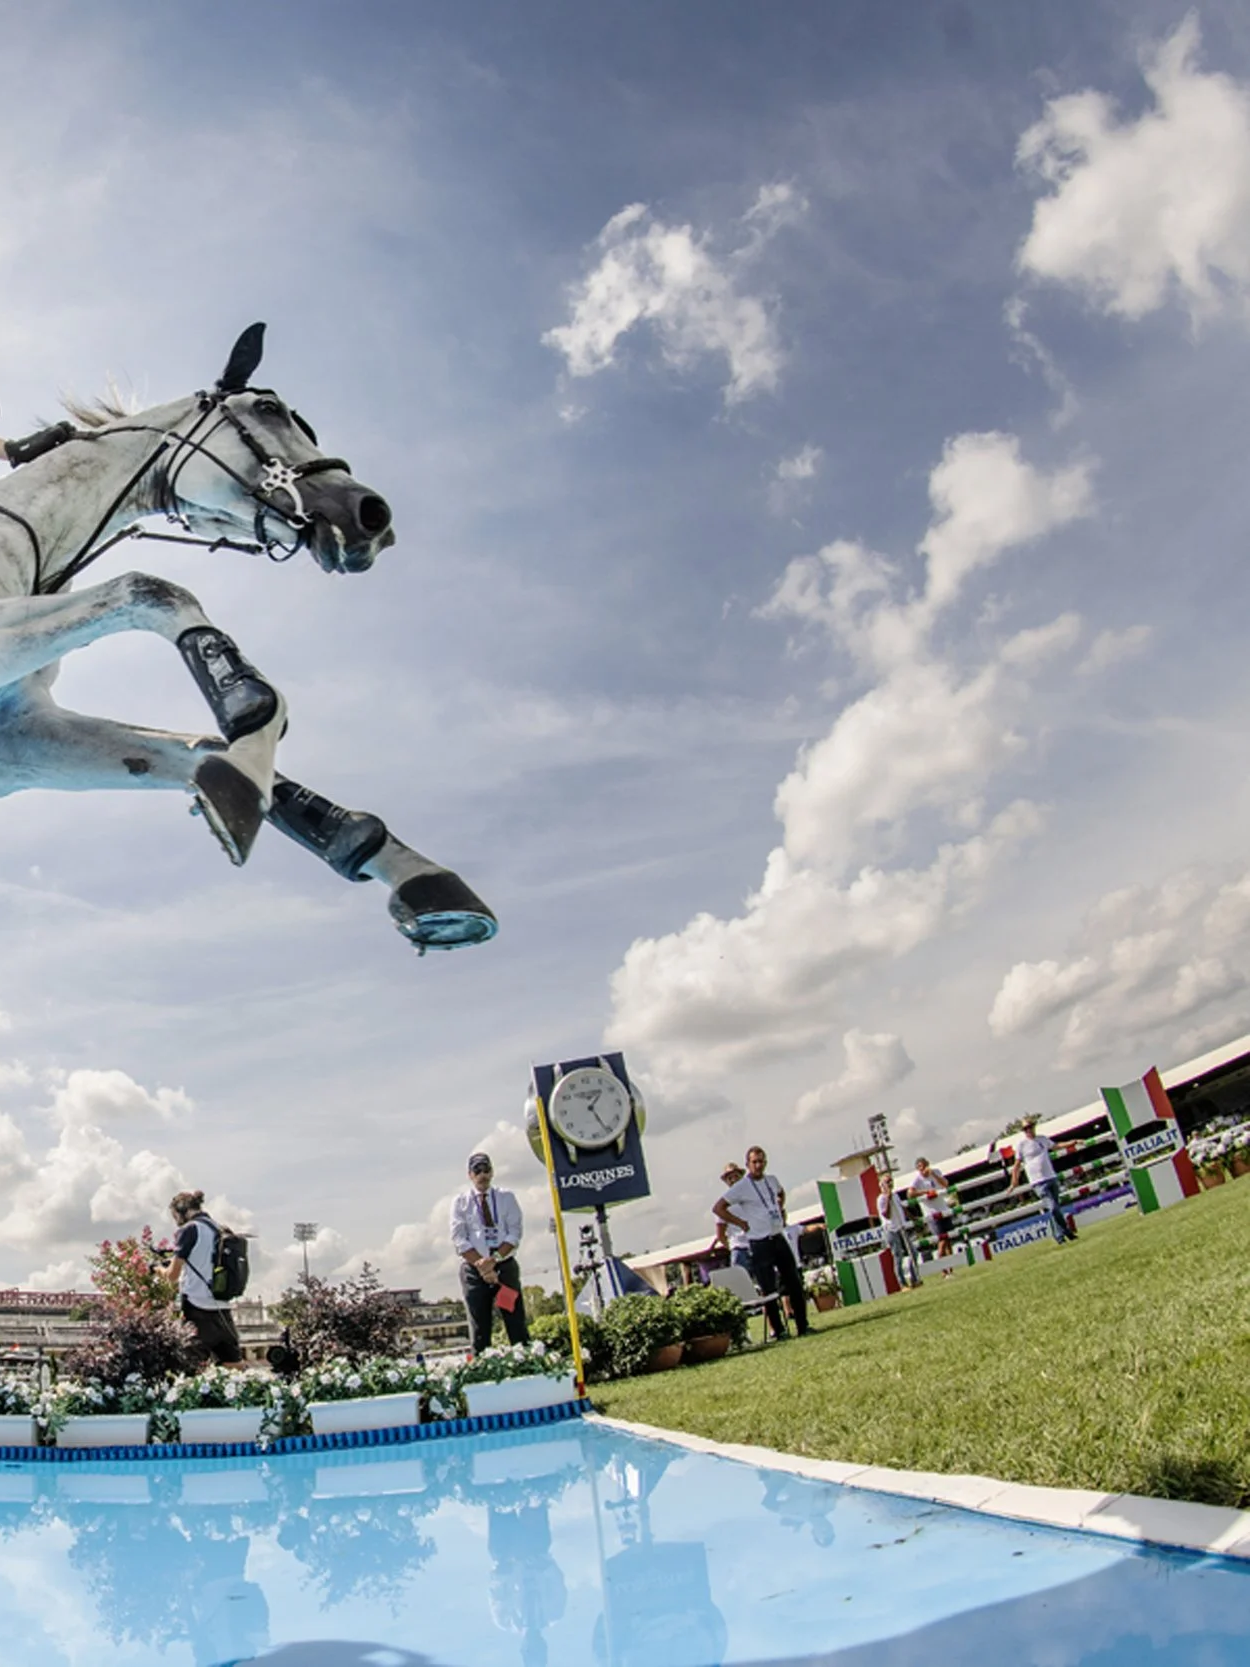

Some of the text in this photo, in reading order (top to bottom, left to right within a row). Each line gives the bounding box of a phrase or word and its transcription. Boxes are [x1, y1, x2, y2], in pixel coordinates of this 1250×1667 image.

[1124, 1128, 1178, 1158] ITALIA.IT
[559, 1164, 635, 1188] LONGINES
[833, 1226, 886, 1250] ITALIA.I
[993, 1227, 1048, 1253] ITALIA.IT
